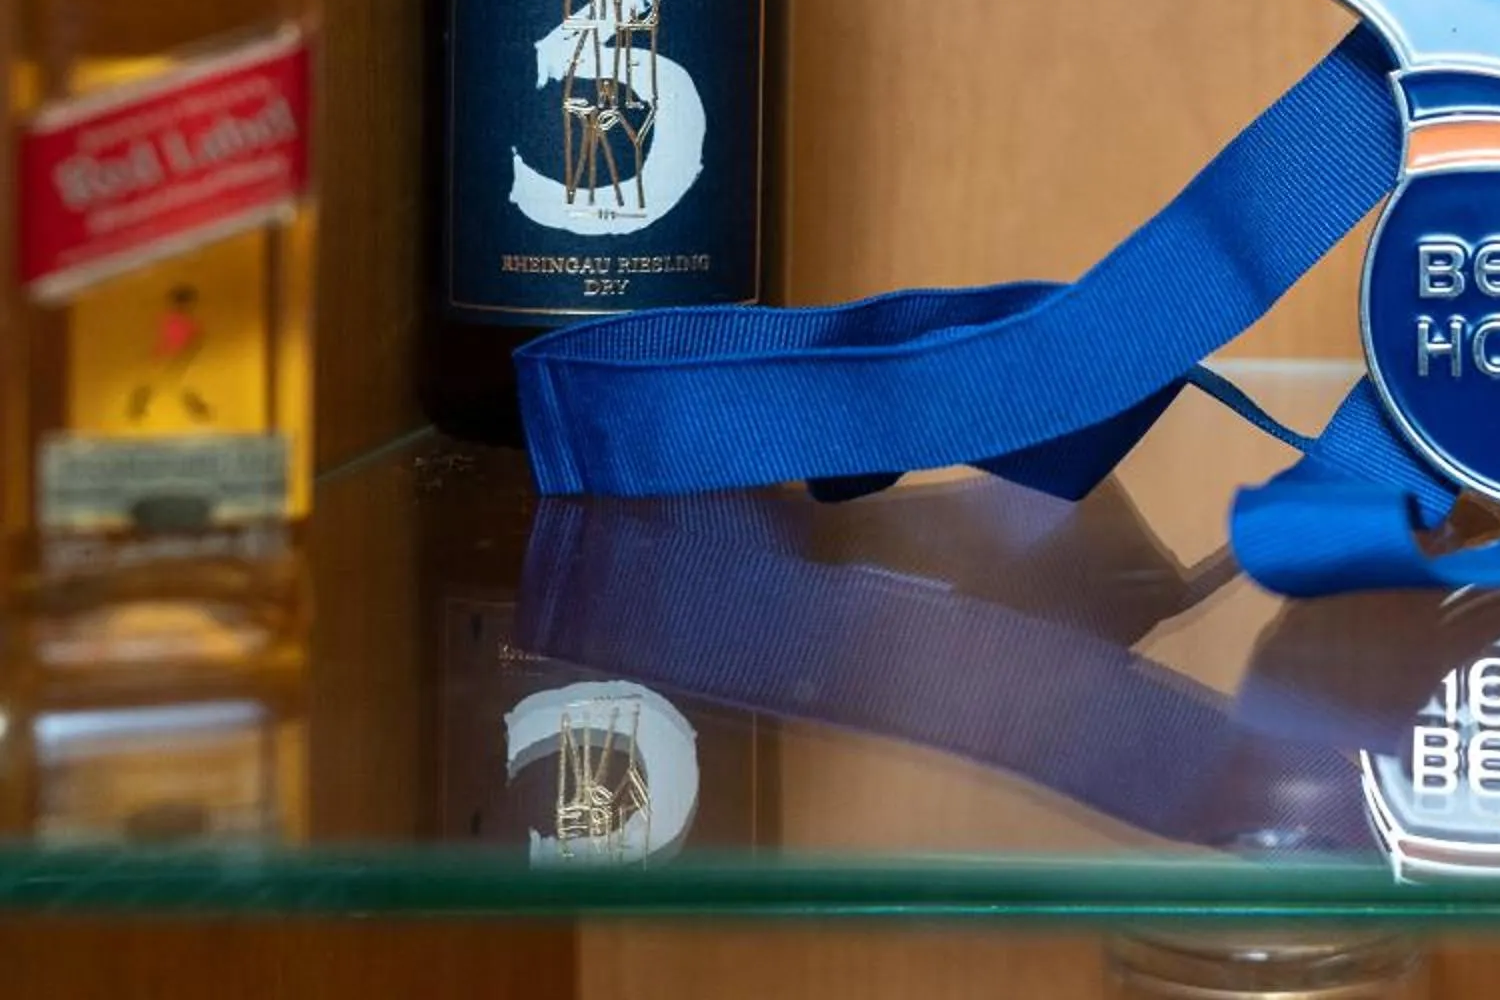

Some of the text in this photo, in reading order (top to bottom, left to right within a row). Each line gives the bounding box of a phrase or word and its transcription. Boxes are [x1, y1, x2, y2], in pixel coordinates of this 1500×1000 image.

[502, 255, 710, 274] RHEINGAU RIESLING
[583, 278, 631, 297] DRY
